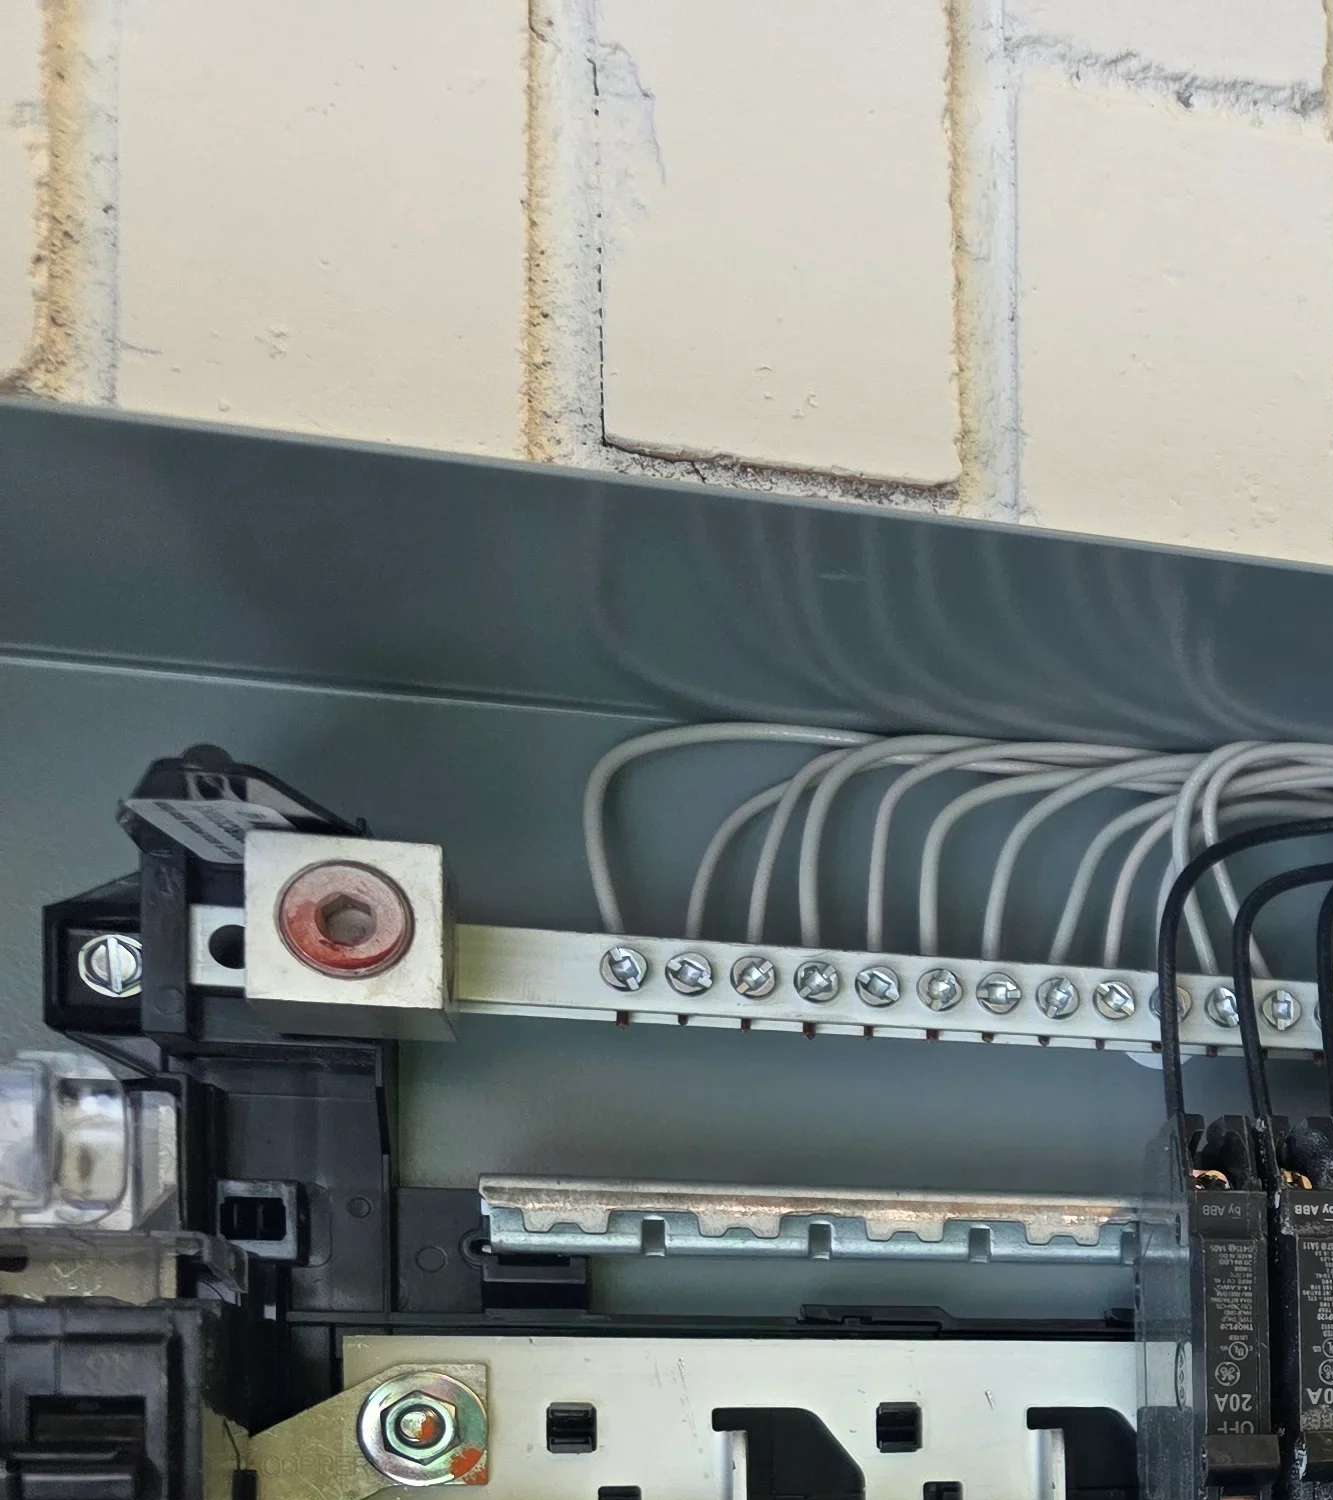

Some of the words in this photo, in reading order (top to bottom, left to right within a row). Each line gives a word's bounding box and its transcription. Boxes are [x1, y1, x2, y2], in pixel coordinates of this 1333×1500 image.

[1203, 1205, 1225, 1215] ABB
[1227, 1204, 1241, 1216] by
[1294, 1205, 1318, 1214] ABB
[1214, 1394, 1252, 1412] 20A
